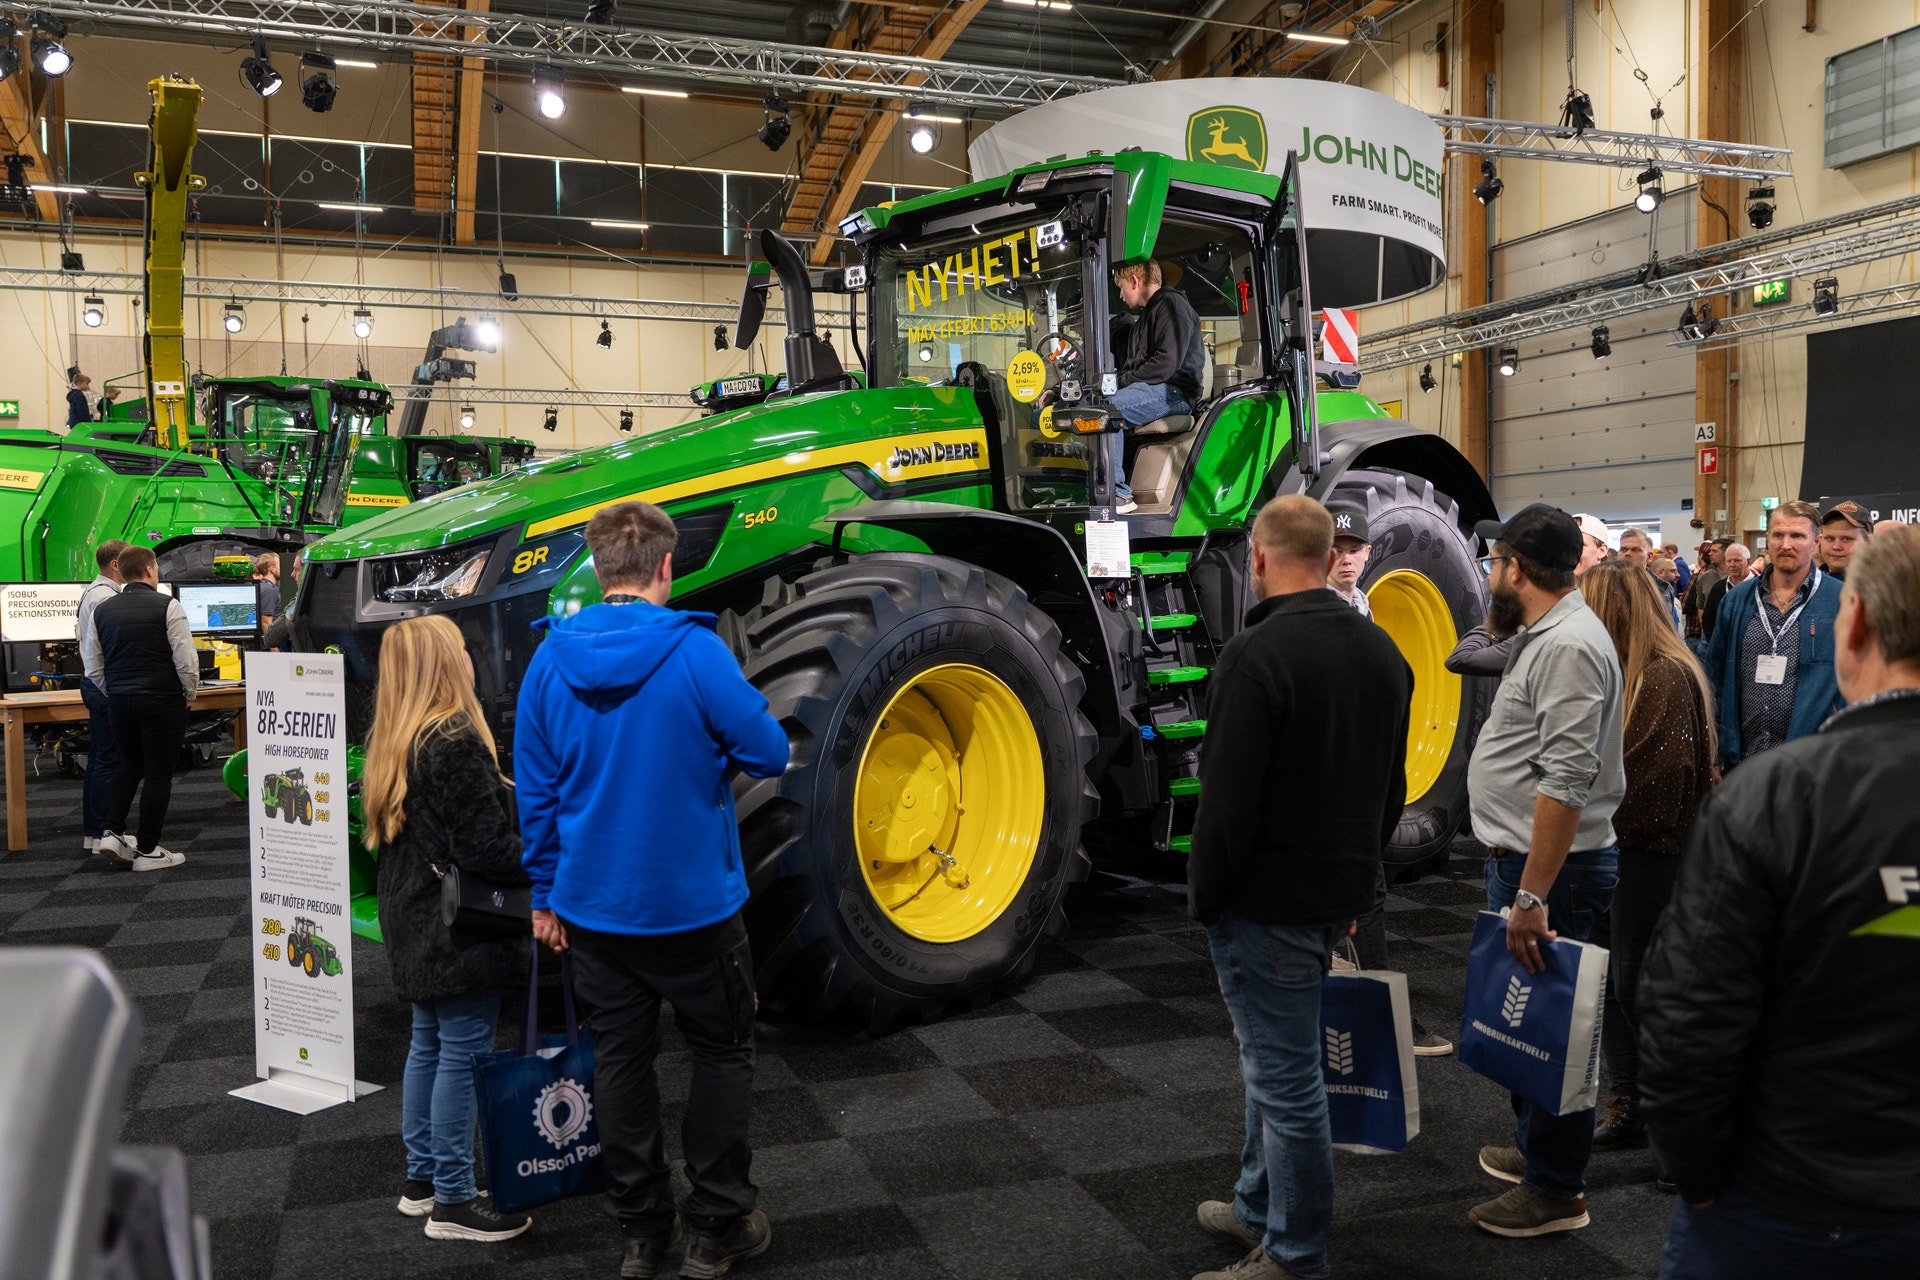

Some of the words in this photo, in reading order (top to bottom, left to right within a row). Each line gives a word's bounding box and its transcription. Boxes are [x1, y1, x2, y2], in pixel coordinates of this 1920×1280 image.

[1297, 126, 1388, 175] JOHN
[1331, 194, 1366, 209] FARM
[1368, 199, 1402, 219] SMART.
[1402, 209, 1427, 229] PROFIT
[906, 226, 1040, 313] NYHET!
[907, 322, 937, 344] MAX
[939, 315, 987, 338] EFFEKT
[1013, 361, 1040, 376] 2,69%
[723, 382, 734, 394] MA
[748, 379, 758, 390] 94
[1696, 425, 1715, 441] A3
[891, 446, 932, 469] JOHN
[932, 441, 980, 462] DEERE
[362, 496, 402, 504] DEERE
[743, 505, 778, 530] 540
[1336, 513, 1351, 529] NY
[512, 545, 549, 574] 8R
[7, 590, 38, 599] ISOBUS
[8, 599, 80, 608] PRECISIONSODLIN
[256, 690, 275, 707] NYA
[257, 709, 336, 740] 8R-SERIEN
[264, 744, 281, 757] HIGH
[282, 745, 329, 761] HORSEPOWER
[313, 771, 330, 785] 440
[314, 790, 330, 804] 490
[314, 809, 330, 822] 540
[260, 826, 265, 840] 1
[260, 847, 266, 860] 2
[261, 865, 267, 879] 3
[259, 891, 282, 906] KRAFT
[282, 893, 306, 911] MÖTER
[306, 898, 342, 917] PRECISION
[261, 918, 286, 936] 280-
[262, 943, 281, 961] 410
[263, 977, 268, 990] 1
[264, 997, 270, 1010] 2
[264, 1018, 270, 1031] 3
[1471, 1018, 1551, 1062] JORDBRUKSAKTUELLT
[517, 1151, 576, 1177] Olsson
